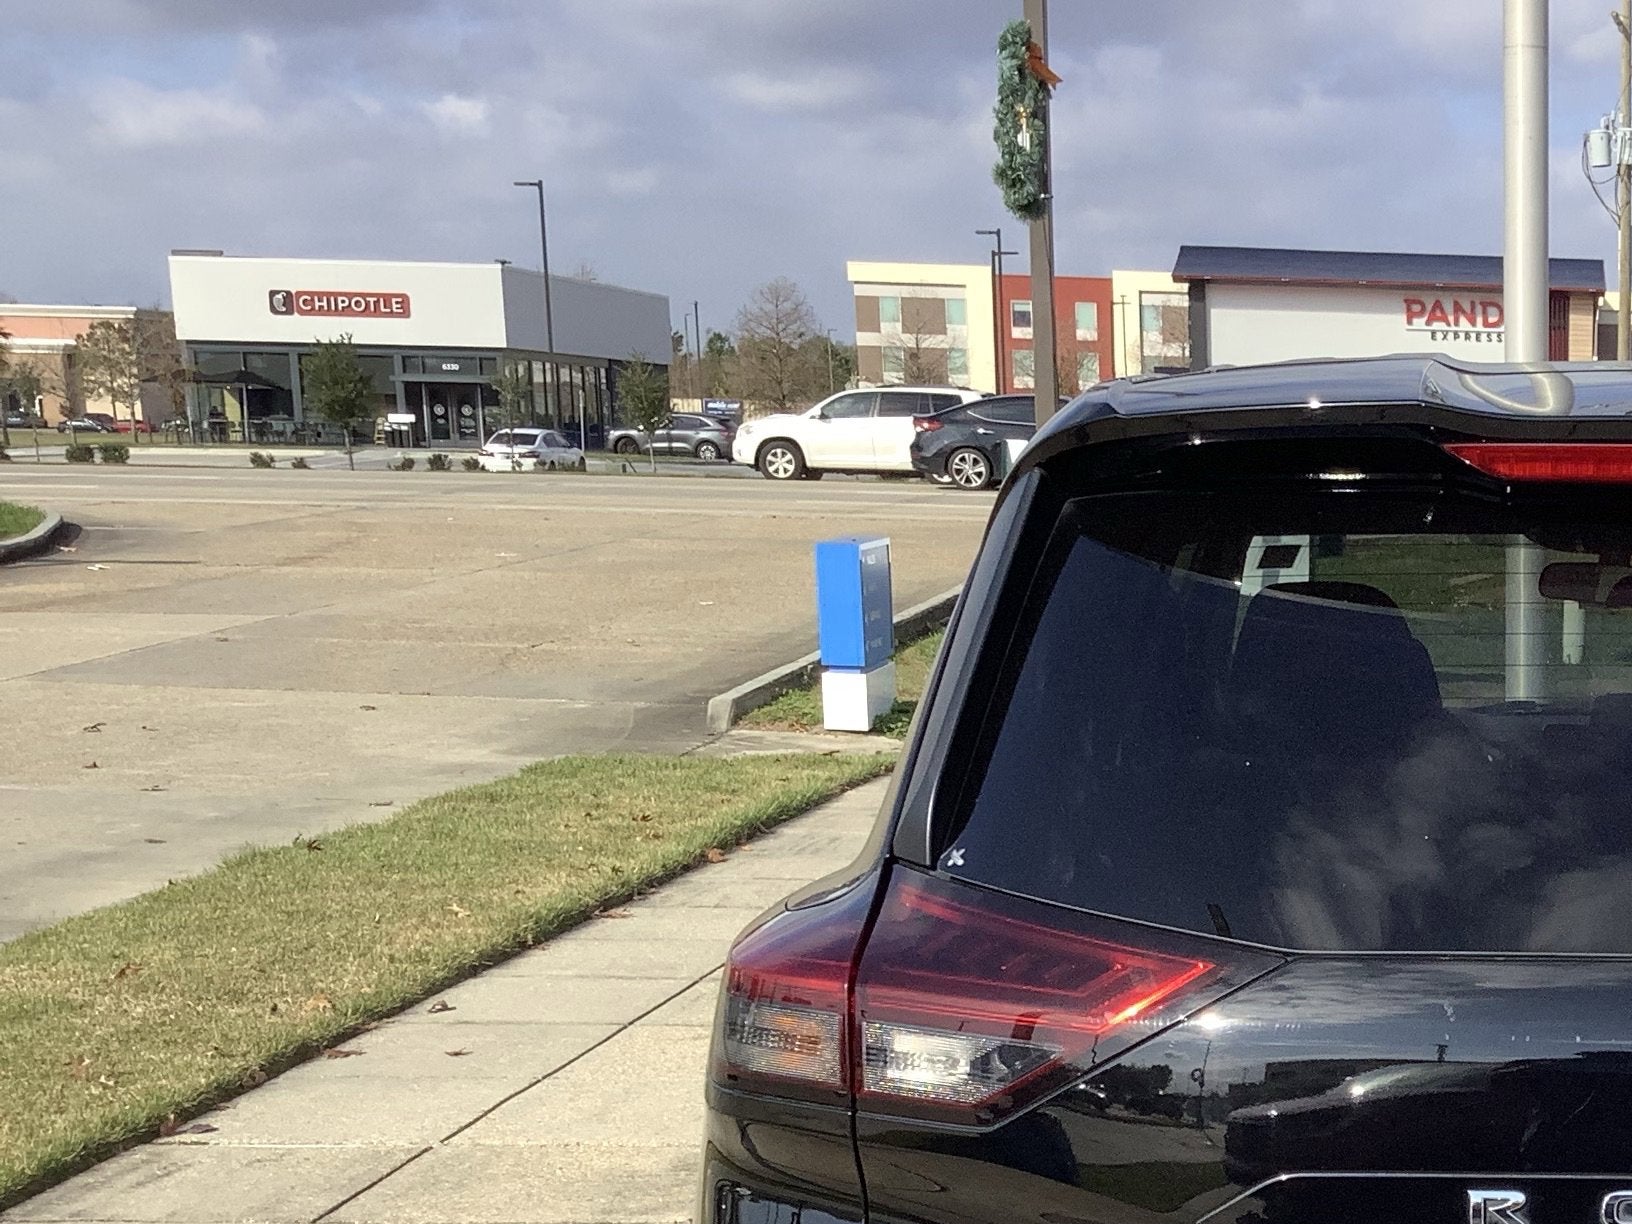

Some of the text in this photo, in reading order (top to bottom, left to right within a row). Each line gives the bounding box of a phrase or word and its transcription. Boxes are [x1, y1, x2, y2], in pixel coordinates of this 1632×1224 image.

[299, 295, 404, 313] CHIPOTLE
[1403, 298, 1504, 328] PAND
[1430, 331, 1504, 343] EXPRESS
